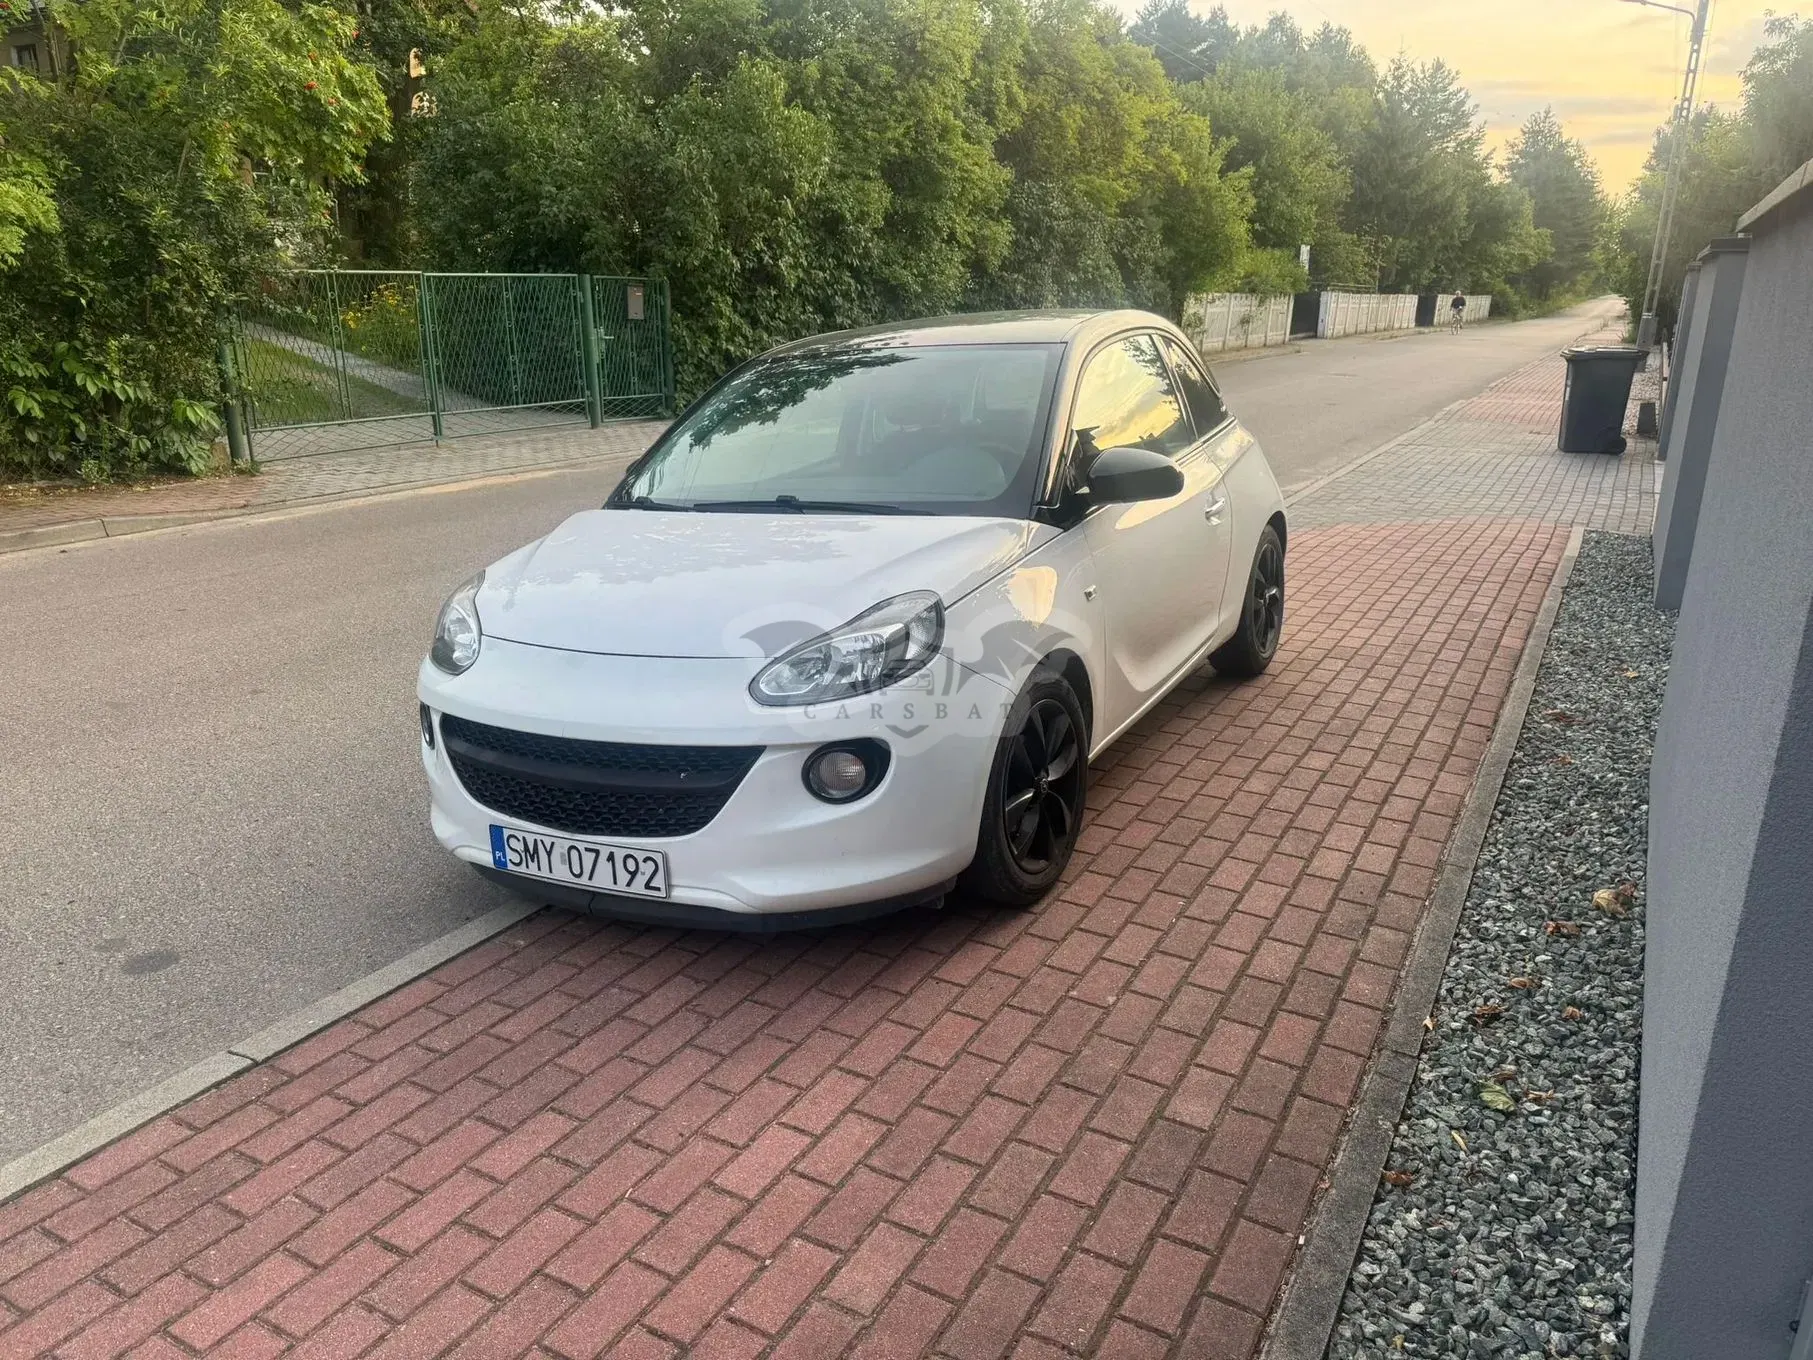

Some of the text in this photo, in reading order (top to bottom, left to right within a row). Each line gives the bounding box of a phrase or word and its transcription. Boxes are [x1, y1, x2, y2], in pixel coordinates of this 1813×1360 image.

[495, 851, 506, 862] PL
[506, 834, 661, 892] SMY 07192
